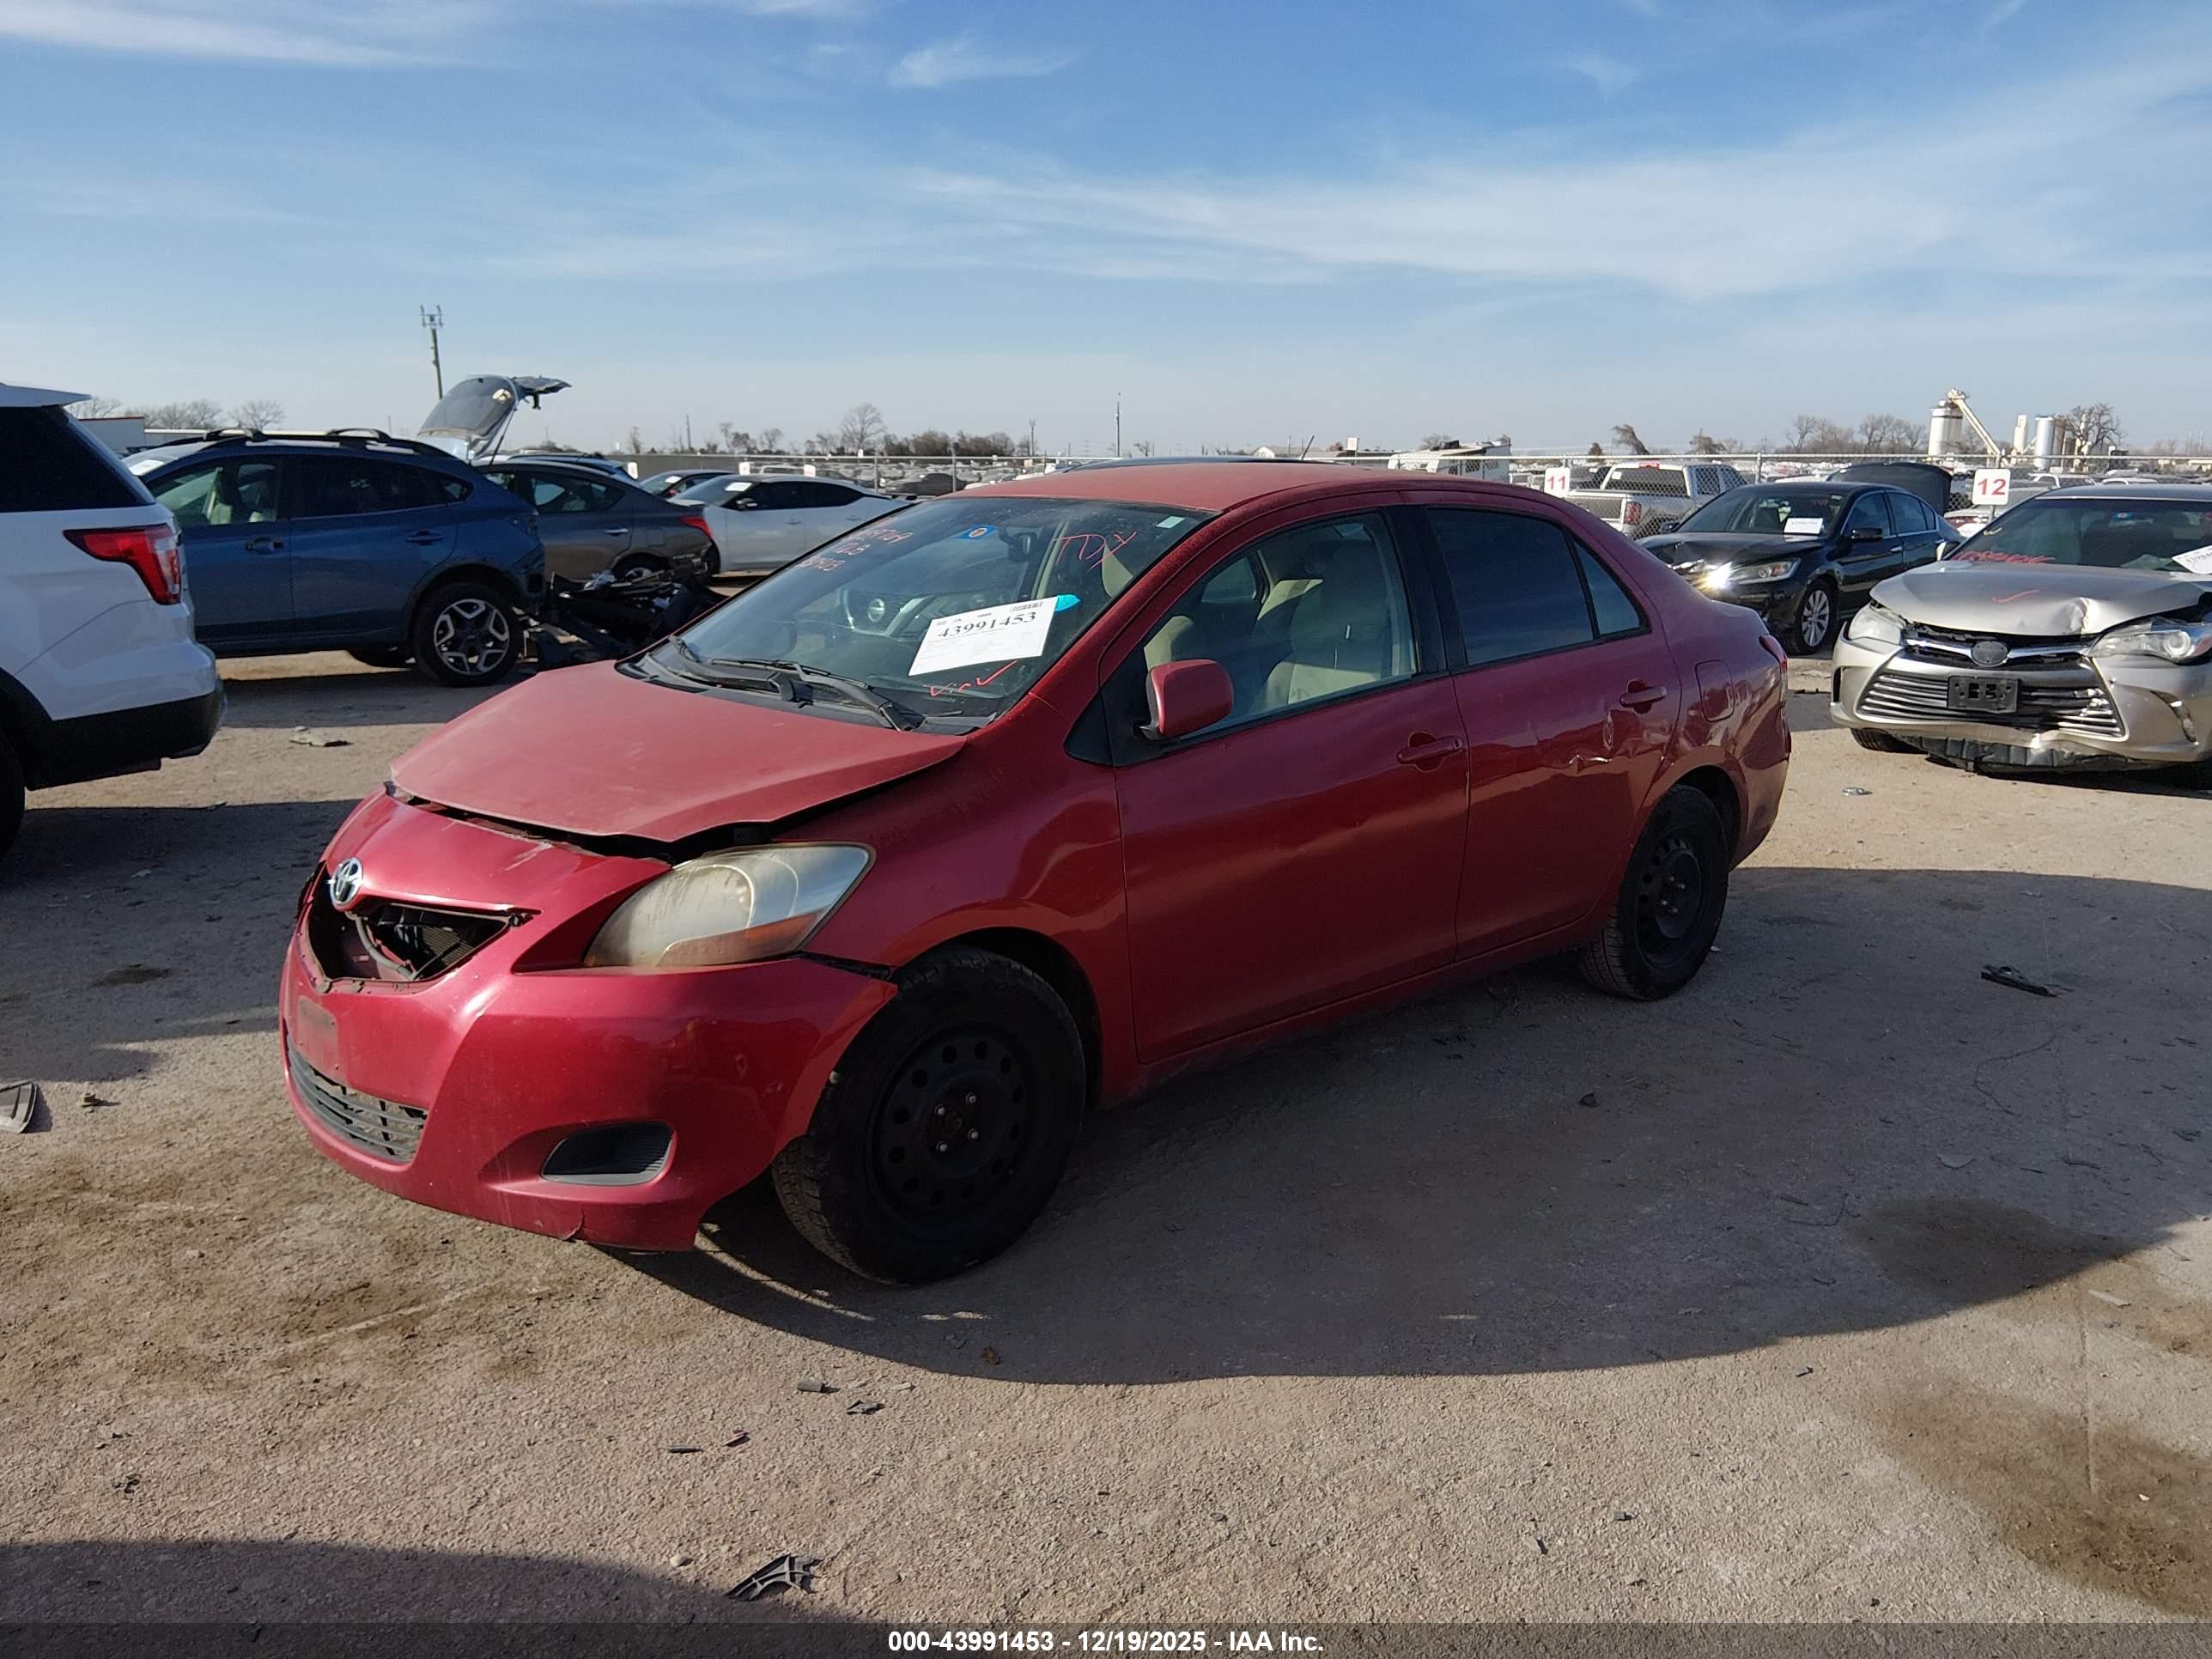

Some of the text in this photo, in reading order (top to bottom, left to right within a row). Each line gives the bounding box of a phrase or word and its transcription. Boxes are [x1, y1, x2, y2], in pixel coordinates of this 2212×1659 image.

[1547, 475, 1565, 490] 11
[1977, 477, 2007, 495] 12
[937, 611, 1036, 637] 43991453
